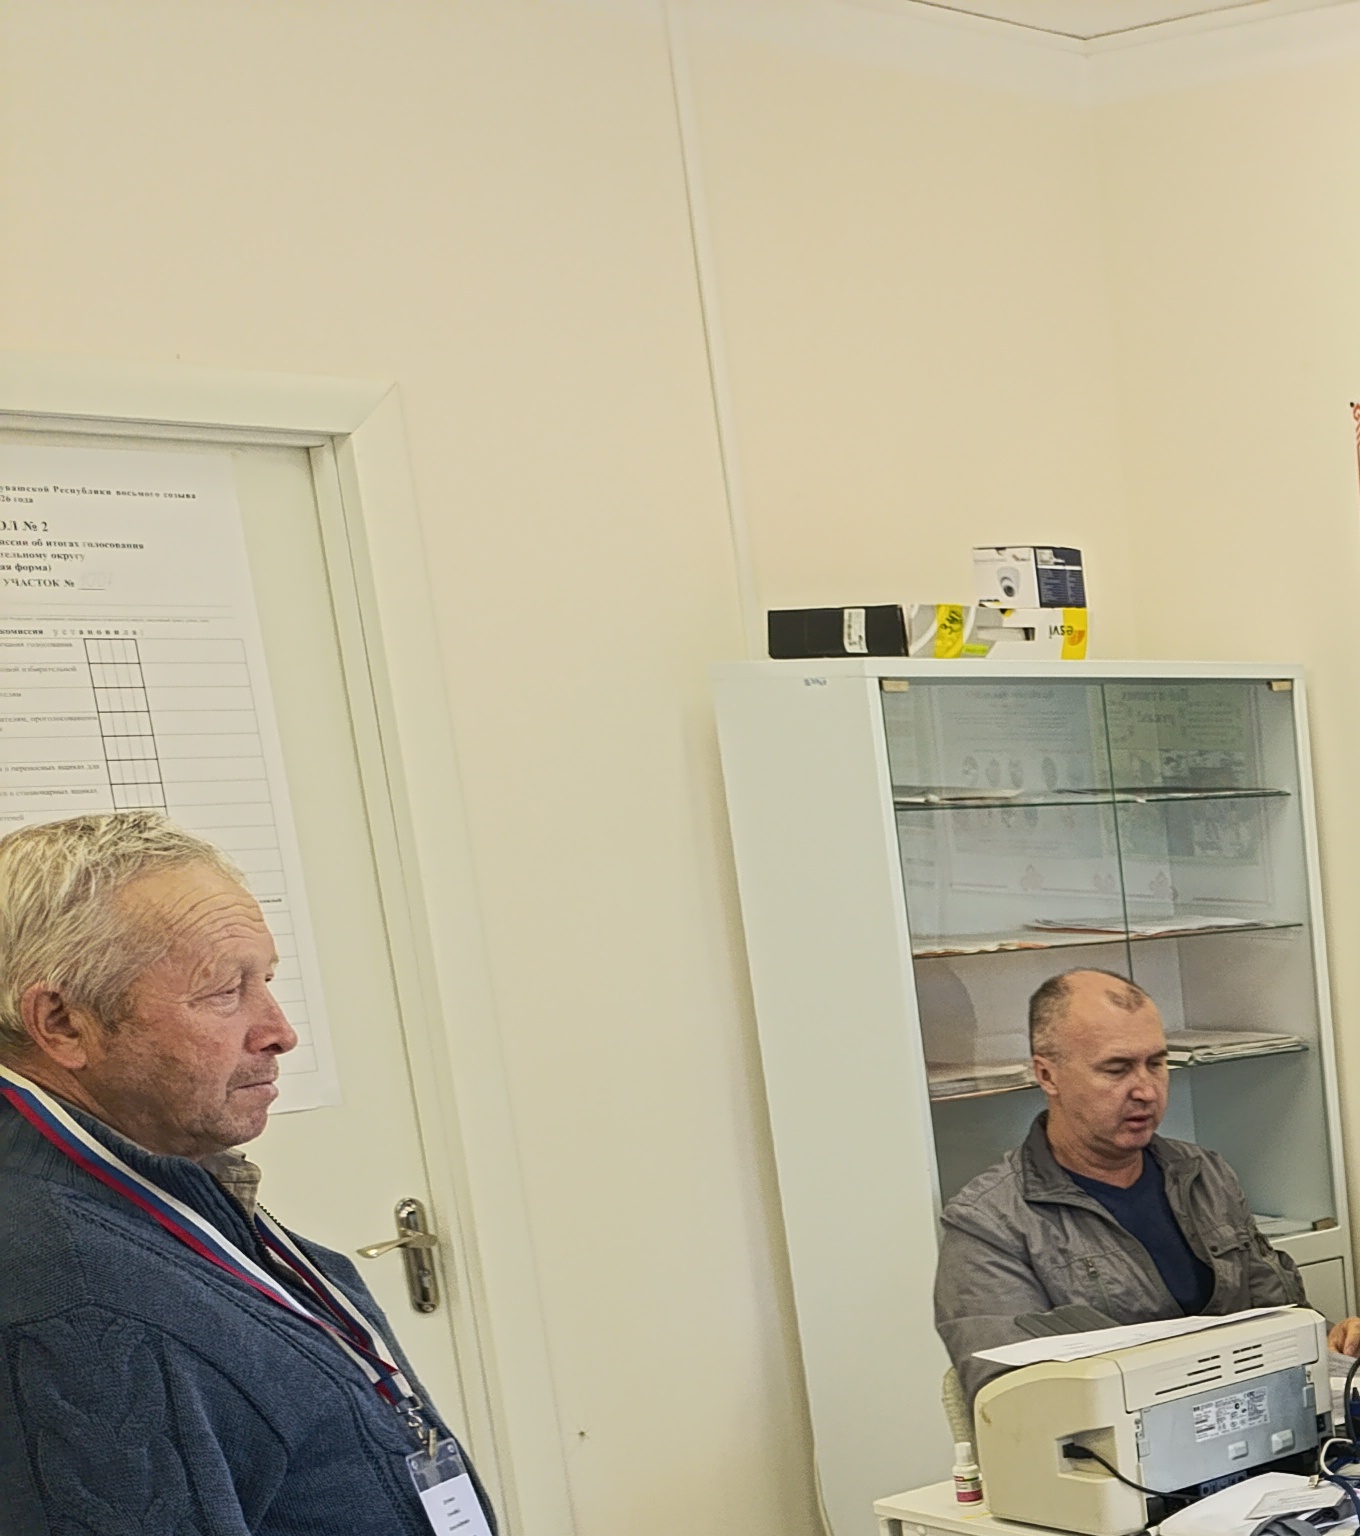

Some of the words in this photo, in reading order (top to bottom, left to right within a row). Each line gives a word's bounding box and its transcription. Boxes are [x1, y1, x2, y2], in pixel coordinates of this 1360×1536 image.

[0, 485, 50, 494] увашской
[53, 486, 112, 496] Республики
[116, 490, 160, 498] восьмого
[22, 521, 38, 532] №
[42, 521, 48, 532] 2
[32, 538, 43, 547] об
[46, 540, 79, 548] итогах
[82, 540, 144, 550] голосования
[0, 552, 47, 560] тельному
[51, 552, 85, 561] округу
[15, 562, 52, 572] форма)
[3, 579, 60, 588] УЧАСТОК
